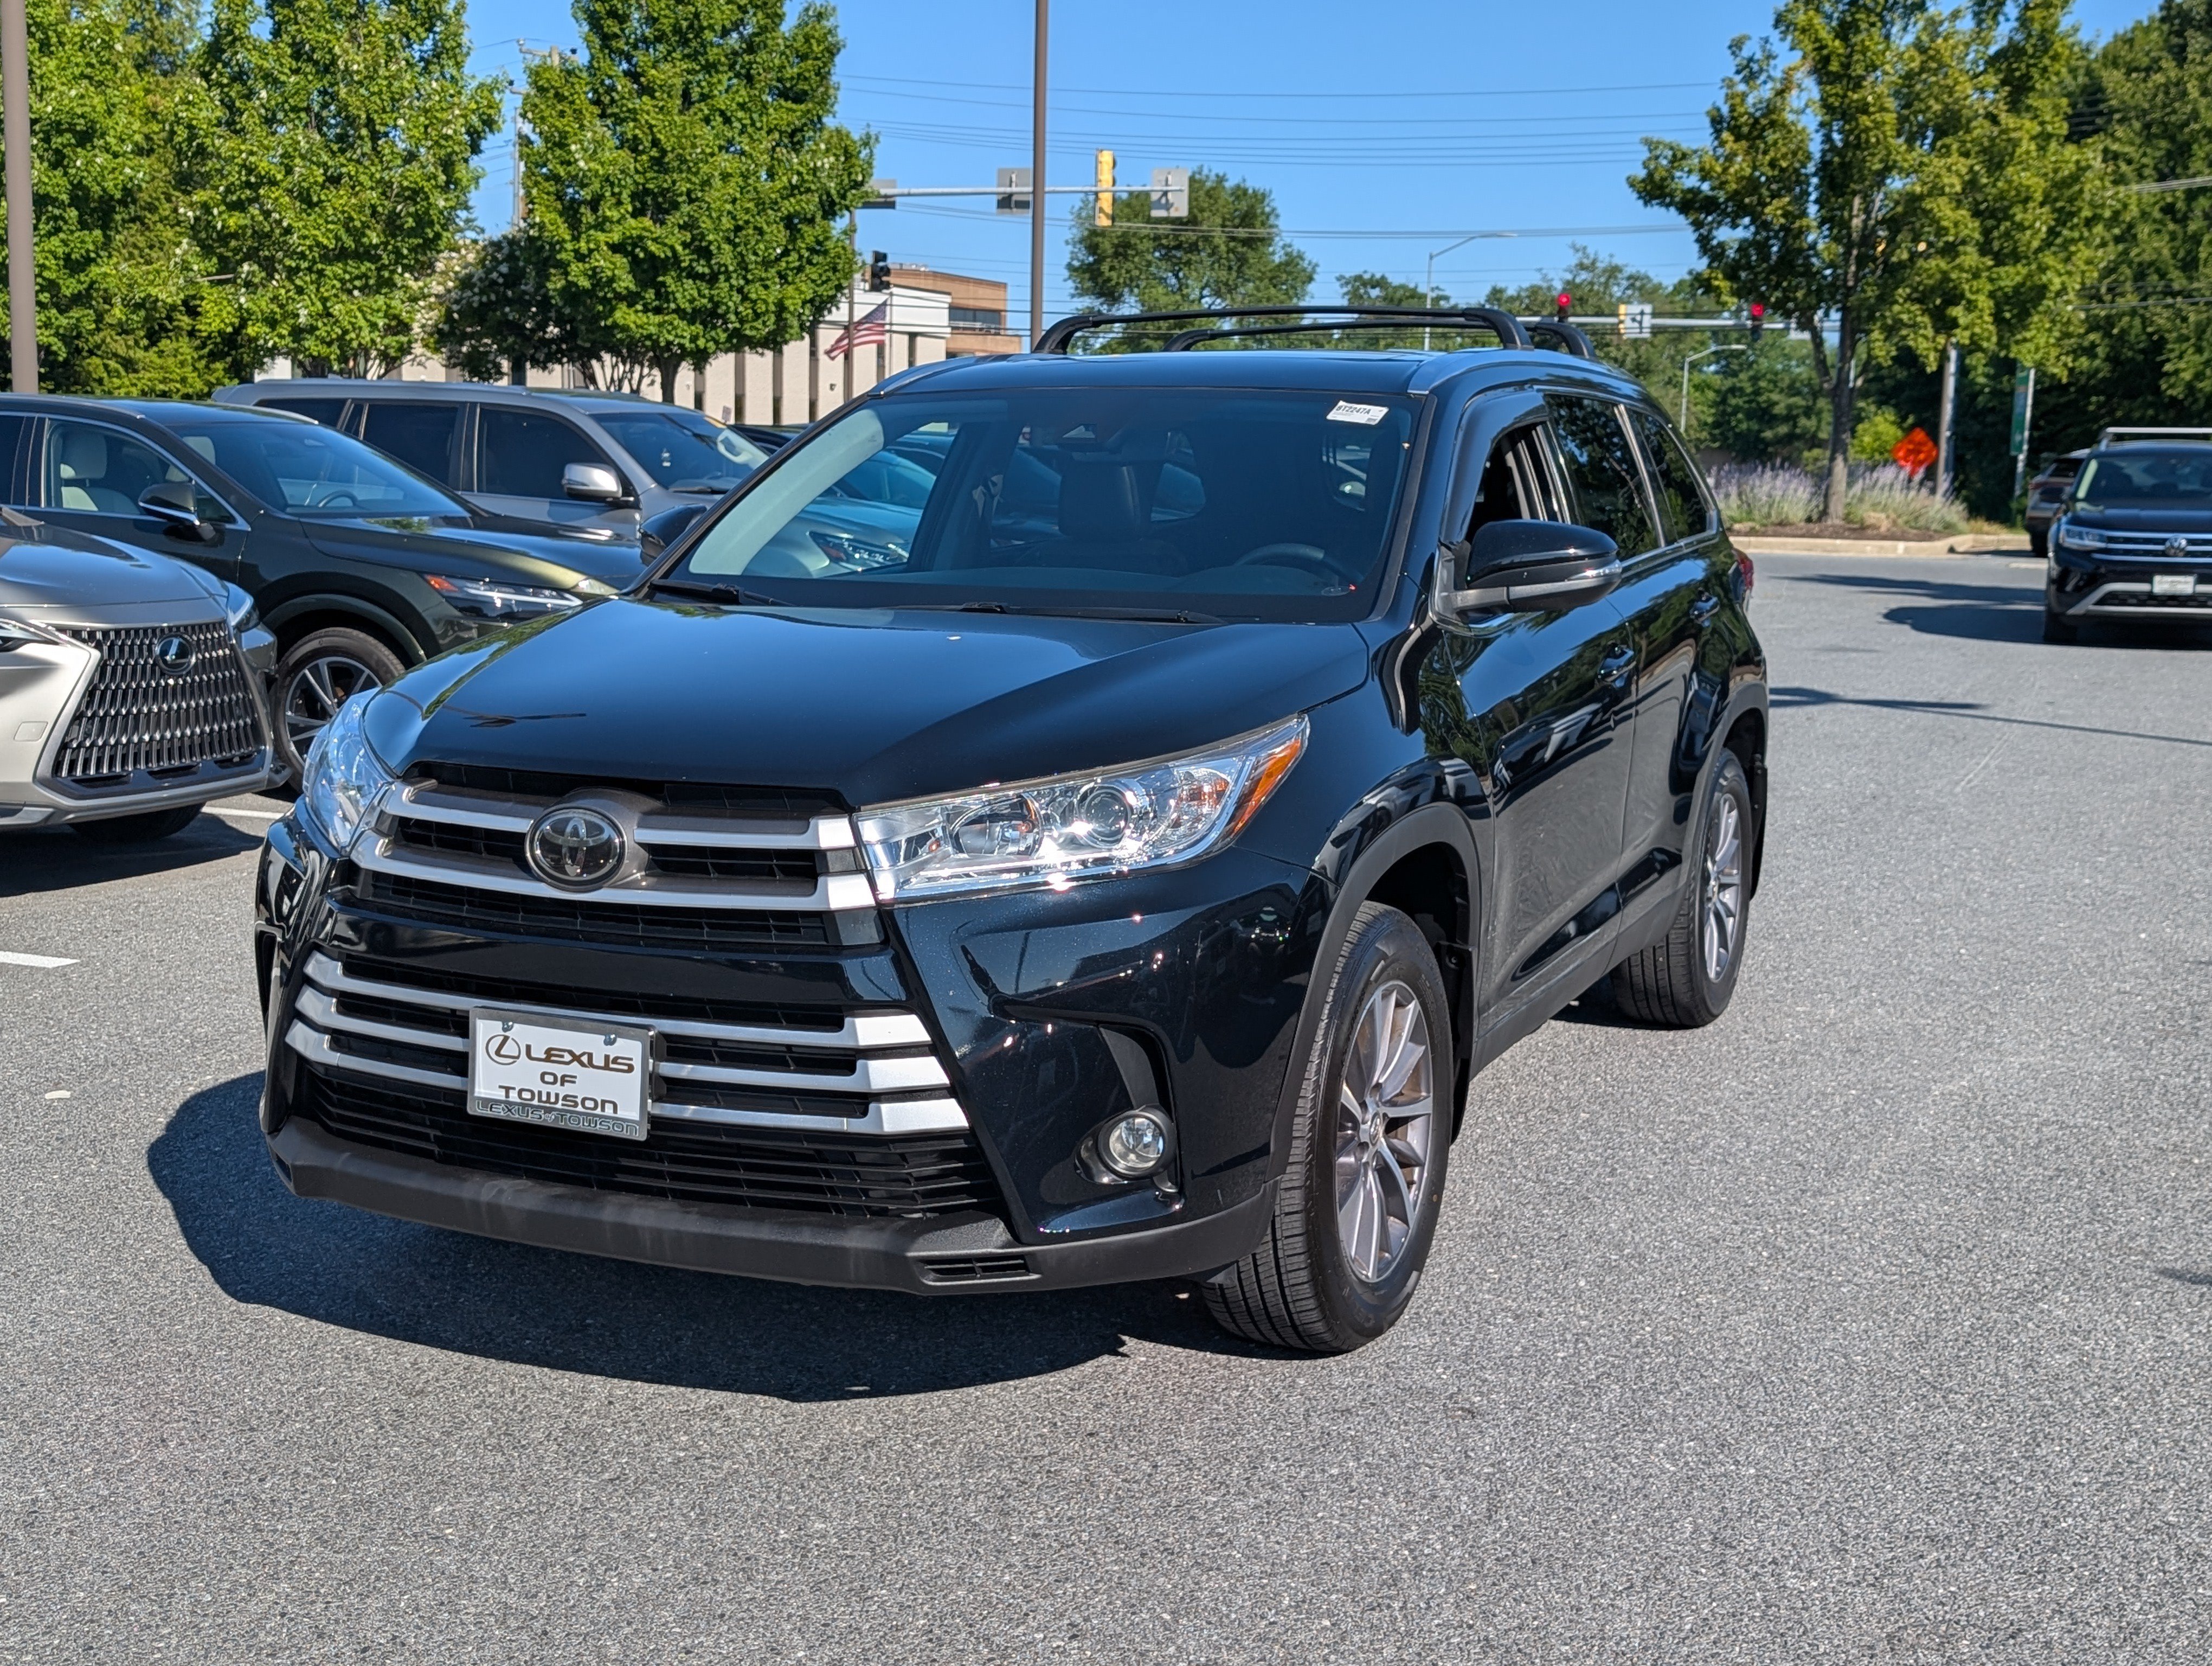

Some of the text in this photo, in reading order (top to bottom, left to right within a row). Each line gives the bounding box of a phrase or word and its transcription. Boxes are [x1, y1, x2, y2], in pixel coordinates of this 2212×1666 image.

[525, 1043, 635, 1074] LEXUS
[540, 1071, 577, 1087] OF
[498, 1085, 618, 1114] TOWSON
[476, 1100, 544, 1120] LEXUS
[556, 1112, 640, 1137] TOWSON
